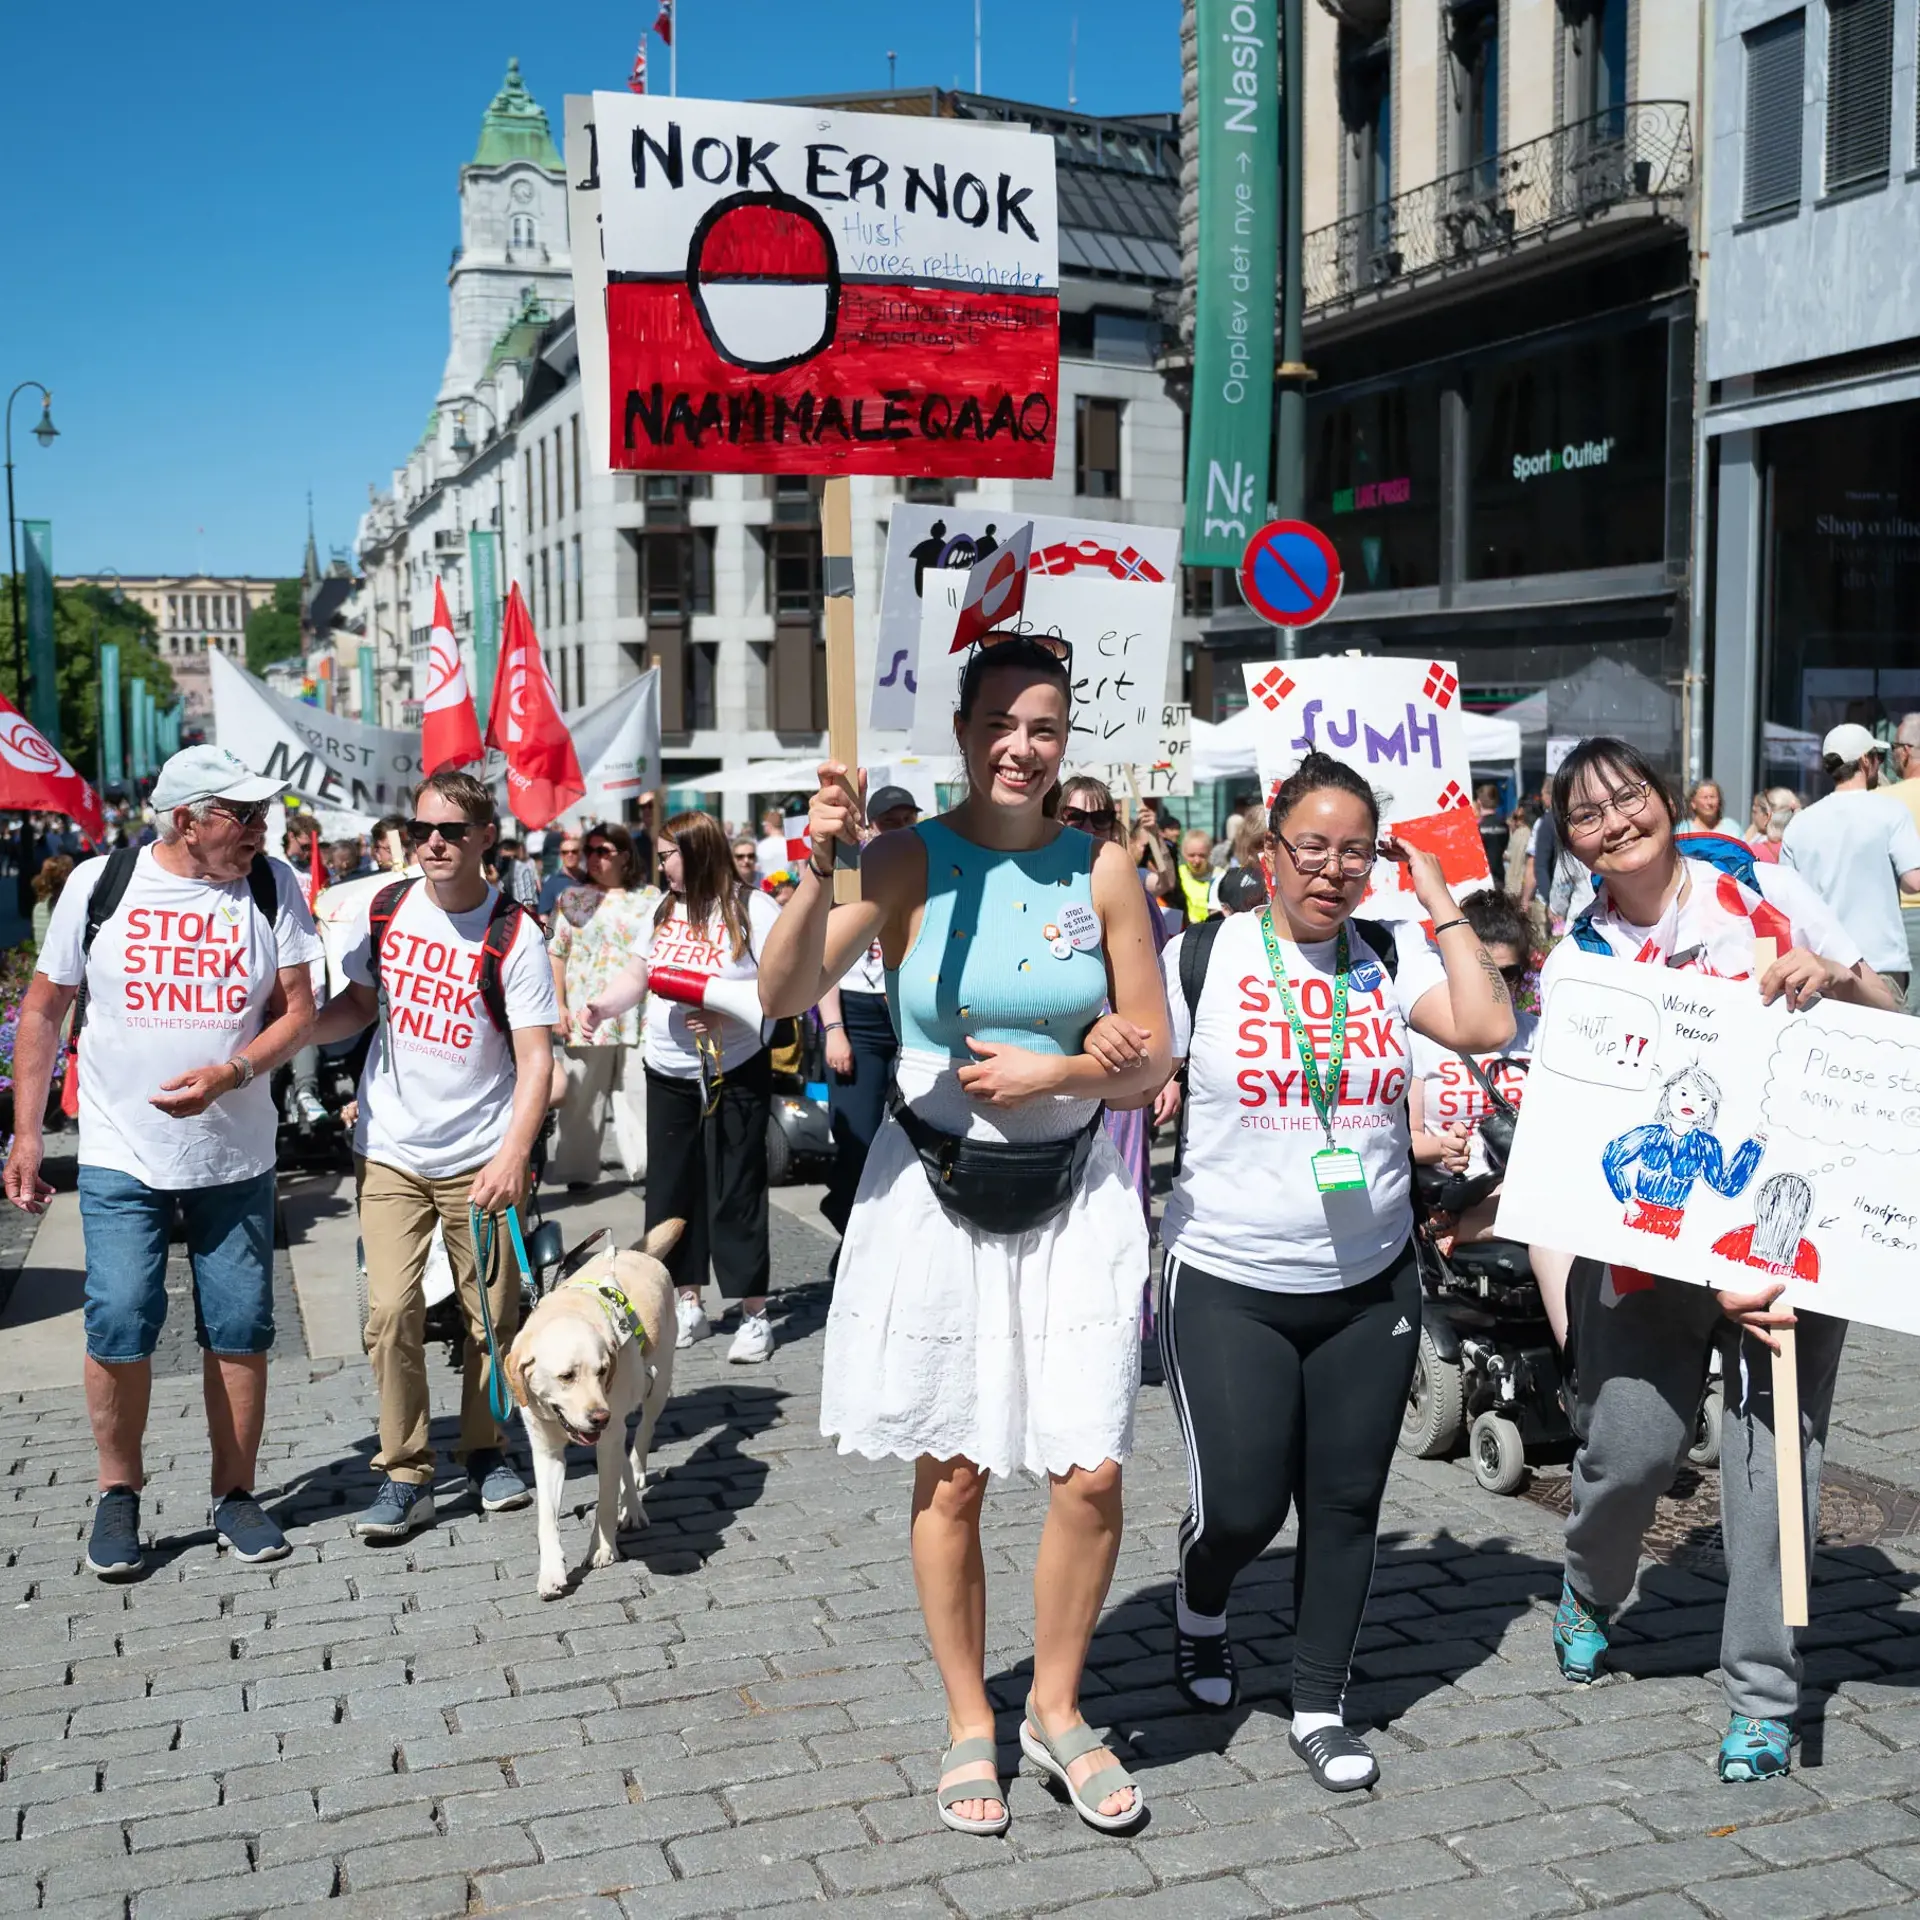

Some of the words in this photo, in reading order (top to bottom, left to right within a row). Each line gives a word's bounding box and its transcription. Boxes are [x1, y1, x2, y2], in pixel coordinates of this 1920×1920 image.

[1222, 0, 1264, 133] Nasjo
[631, 120, 785, 194] NOK
[803, 143, 889, 210] ER
[902, 163, 1041, 243] NOK
[1235, 183, 1255, 235] nye
[842, 211, 906, 247] Husk
[850, 252, 915, 276] vores
[923, 252, 1045, 295] rettigheder
[1229, 245, 1250, 292] det
[1223, 300, 1250, 404] Opplev
[624, 383, 1052, 449] NAAMMALEQAAQ
[1513, 448, 1551, 483] Sport
[1562, 437, 1609, 470] Outlet
[1098, 631, 1142, 657] er
[1290, 699, 1443, 769] SUMH
[1065, 906, 1084, 919] STOLT
[1068, 923, 1096, 937] assistent
[1072, 913, 1093, 926] STERK
[124, 945, 249, 978] STERK
[381, 930, 483, 985] STOLT
[649, 940, 725, 969] STERK
[125, 981, 249, 1014] SYNLIG
[380, 965, 481, 1020] STERK
[1661, 993, 1717, 1018] Worker
[126, 1016, 245, 1030] STOLTHETSPARADEN
[389, 1005, 474, 1050] YNLIG
[1566, 1013, 1614, 1040] SHUT
[1675, 1022, 1720, 1043] Person
[394, 1038, 468, 1065] ETSPARADEN
[1803, 1048, 1879, 1088] Please
[1240, 1114, 1394, 1131] STOLTHETPARADEN
